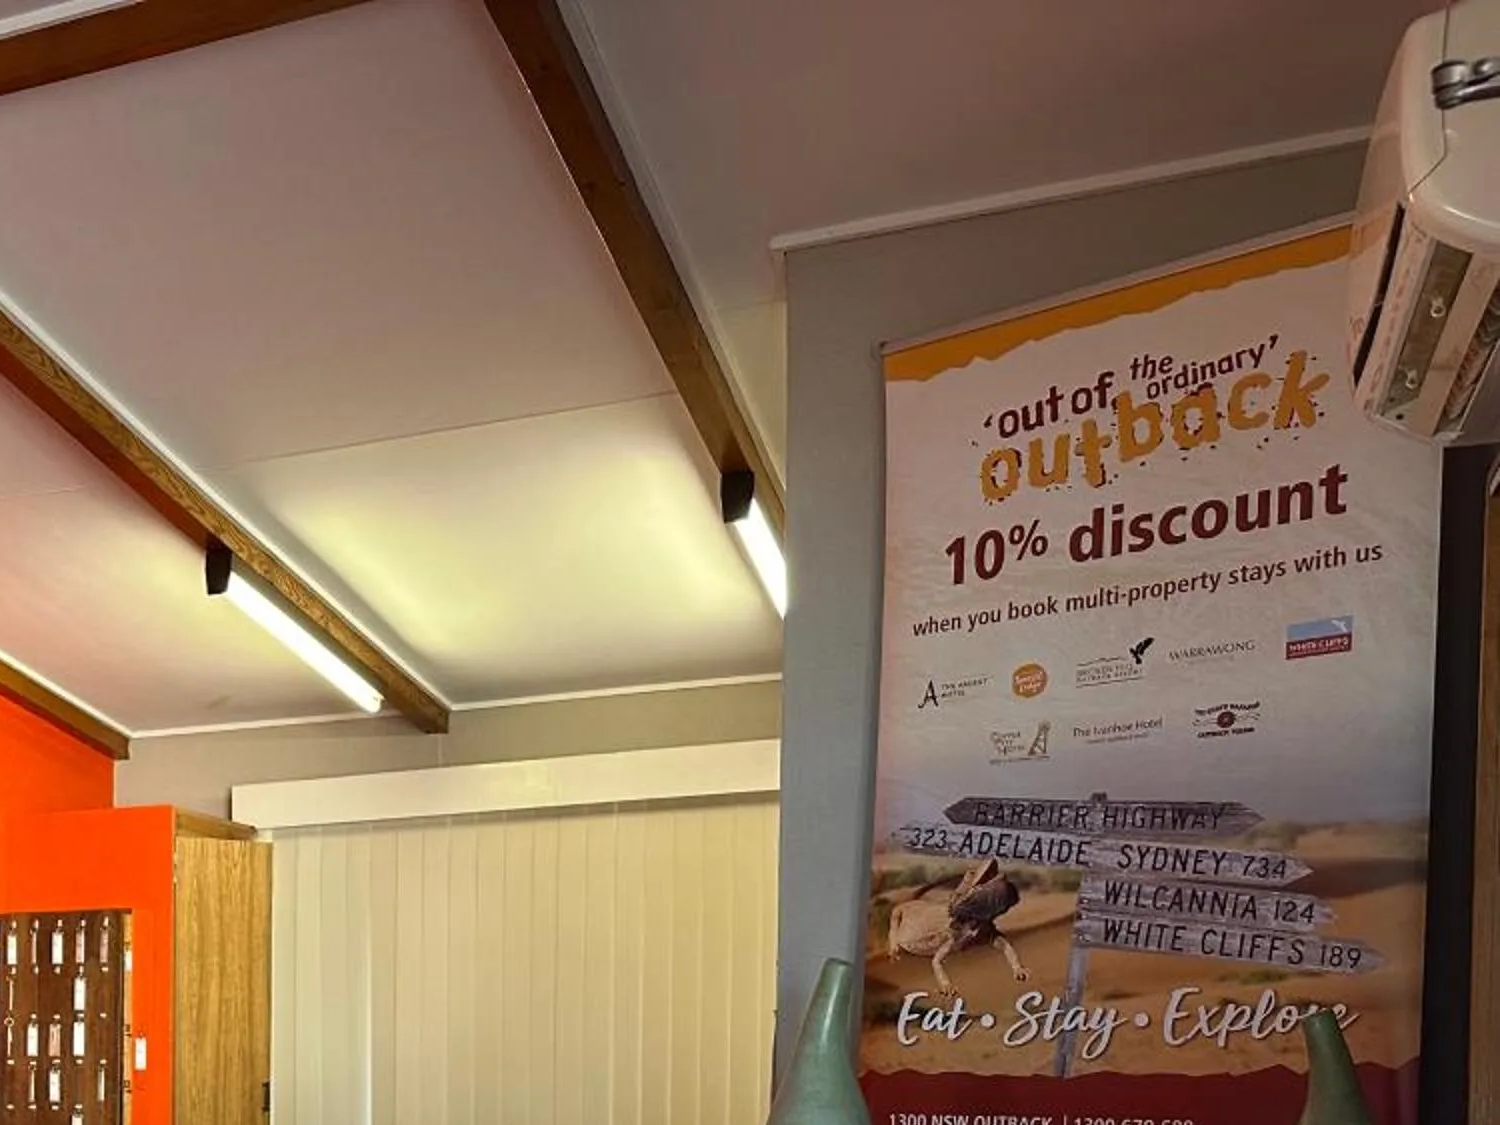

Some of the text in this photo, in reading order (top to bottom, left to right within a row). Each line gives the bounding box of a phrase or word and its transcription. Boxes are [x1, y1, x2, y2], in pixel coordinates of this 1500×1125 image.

[1071, 371, 1114, 415] of
[1130, 354, 1174, 382] the
[980, 350, 1331, 501] outback
[945, 464, 1348, 585] 10% discount
[912, 544, 1383, 637] when you book multi-property stays with us
[1168, 639, 1256, 661] WARRAWONG
[1073, 727, 1090, 737] The
[1135, 716, 1163, 730] Hotel
[975, 801, 1227, 831] BARRIER HIGHWAY
[909, 828, 1093, 866] 323 ADELAIDE
[1117, 844, 1286, 879] SYDNEY 734
[1104, 880, 1315, 924] WILCANNIA 124
[1103, 918, 1362, 969] WHITE CLIFFS 189
[897, 991, 973, 1046] Eat
[1003, 990, 1129, 1060] Stay
